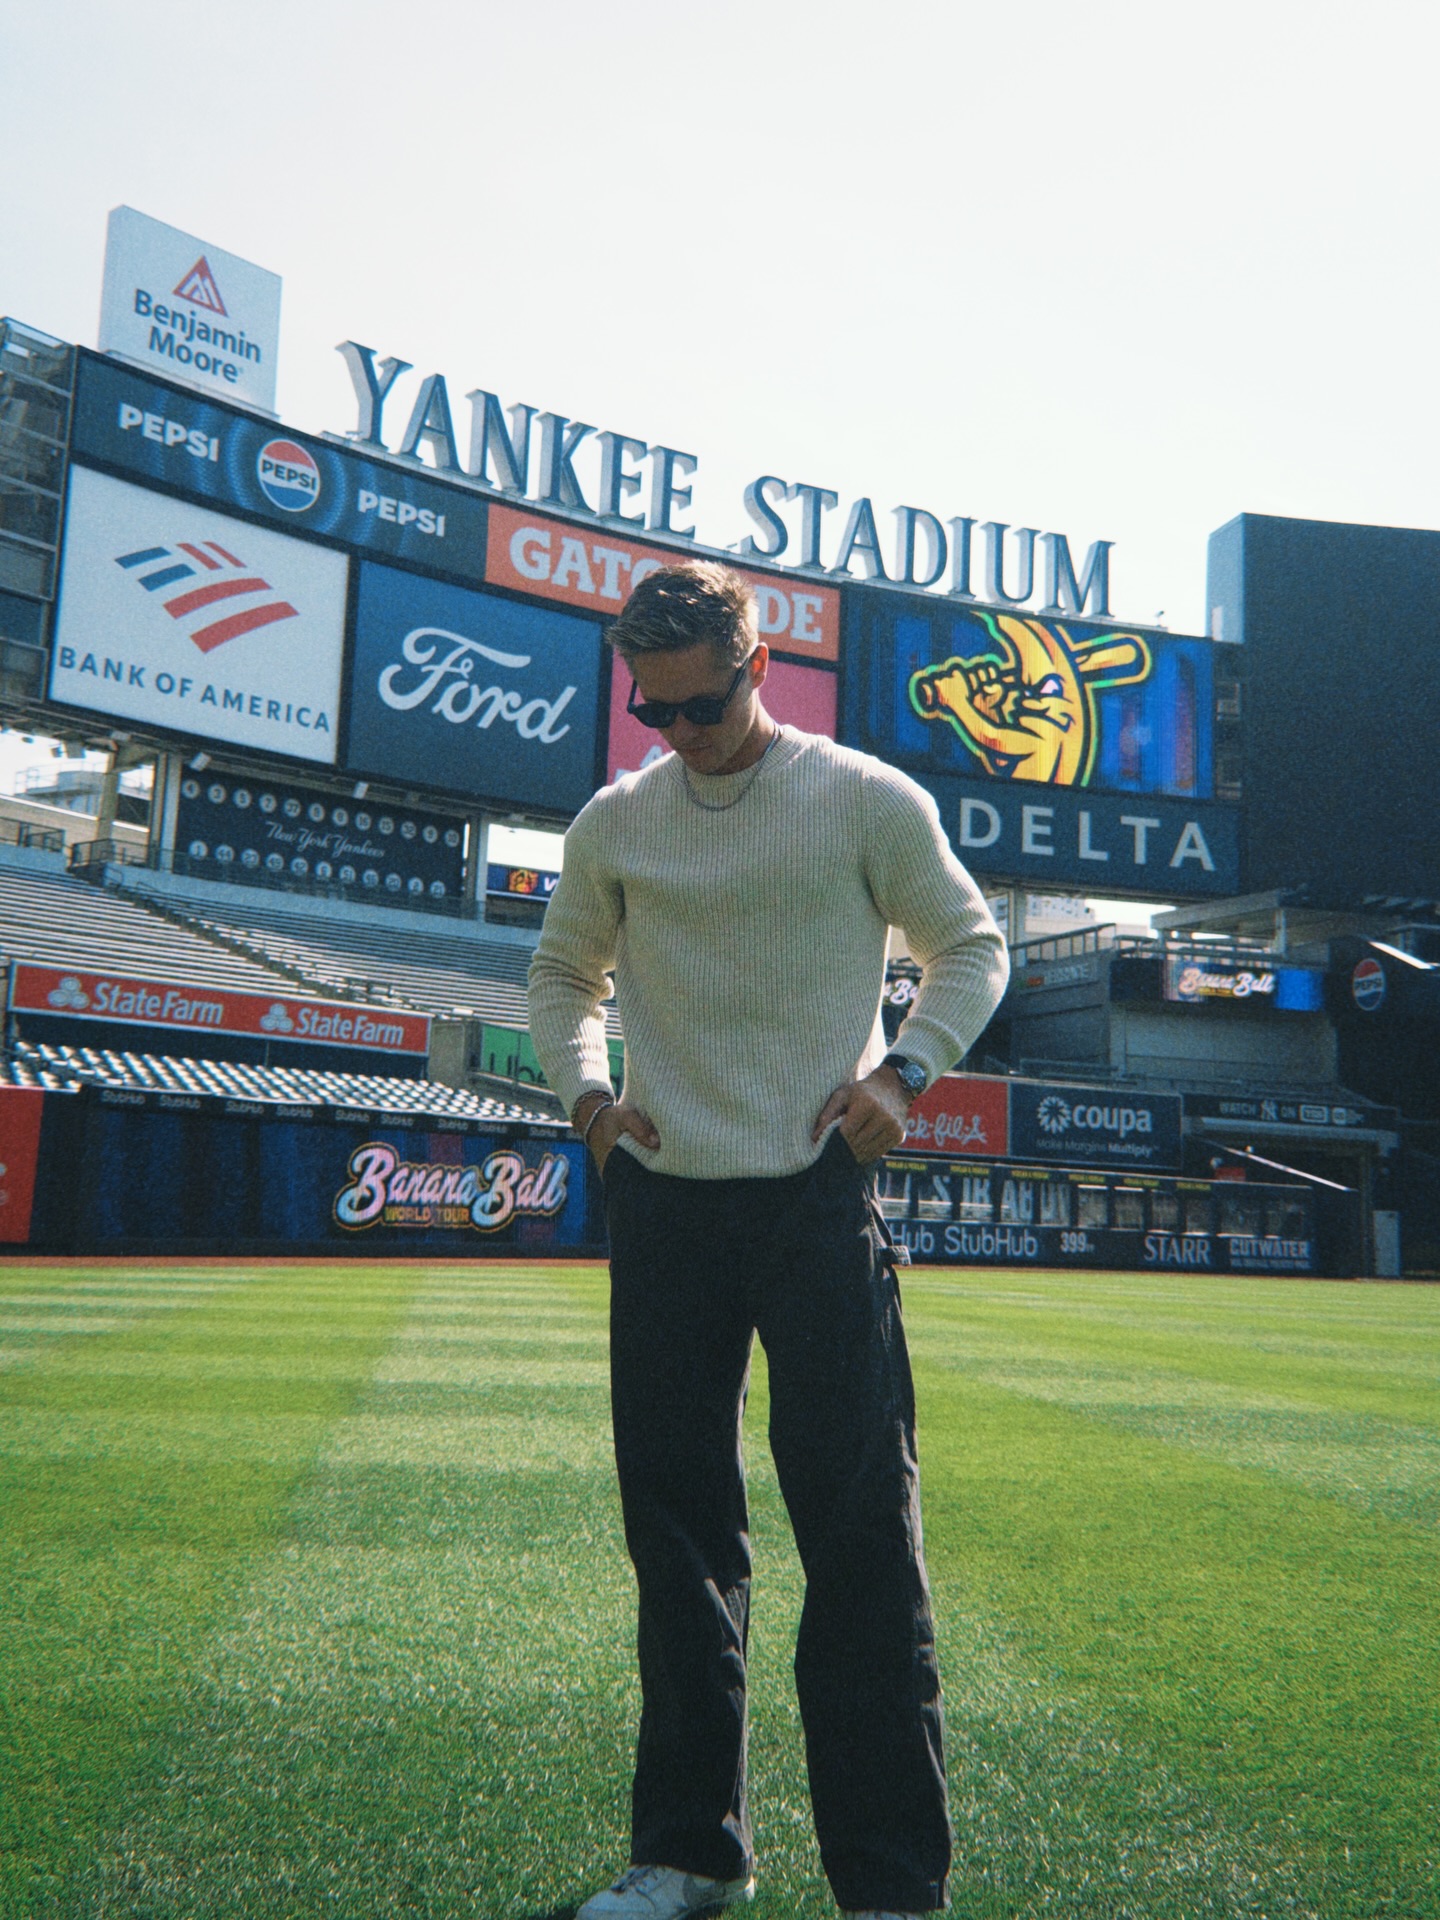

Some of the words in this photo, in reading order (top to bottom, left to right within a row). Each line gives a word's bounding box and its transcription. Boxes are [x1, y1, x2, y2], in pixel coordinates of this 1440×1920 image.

[134, 288, 262, 363] Benjamin
[149, 325, 239, 384] Moore
[118, 402, 219, 462] PEPSI
[261, 458, 316, 491] PEPSI
[335, 339, 699, 539] YANKEE
[743, 475, 1117, 618] STADIUM
[357, 489, 446, 537] PEPSI
[509, 526, 823, 643] GATDE
[58, 646, 146, 689] BANK
[156, 671, 193, 699] OF
[200, 684, 331, 734] AMERICA
[378, 627, 578, 743] Ford
[297, 827, 332, 852] York
[331, 833, 386, 858] Yankees
[959, 797, 1216, 872] DELTA
[1178, 967, 1235, 993] Banana
[1233, 972, 1275, 996] Ball
[1072, 1104, 1152, 1137] coupa
[1281, 1105, 1296, 1118] ON
[905, 1112, 987, 1146] ck-fil-A
[335, 1147, 480, 1225] Banana
[472, 1154, 569, 1228] Ball
[385, 1206, 431, 1222] WORLD
[436, 1207, 470, 1222] TOUR
[944, 1225, 1039, 1257] StubHub
[1060, 1231, 1087, 1254] 399
[1144, 1235, 1211, 1265] STARR
[1229, 1238, 1311, 1259] CUTWATER
